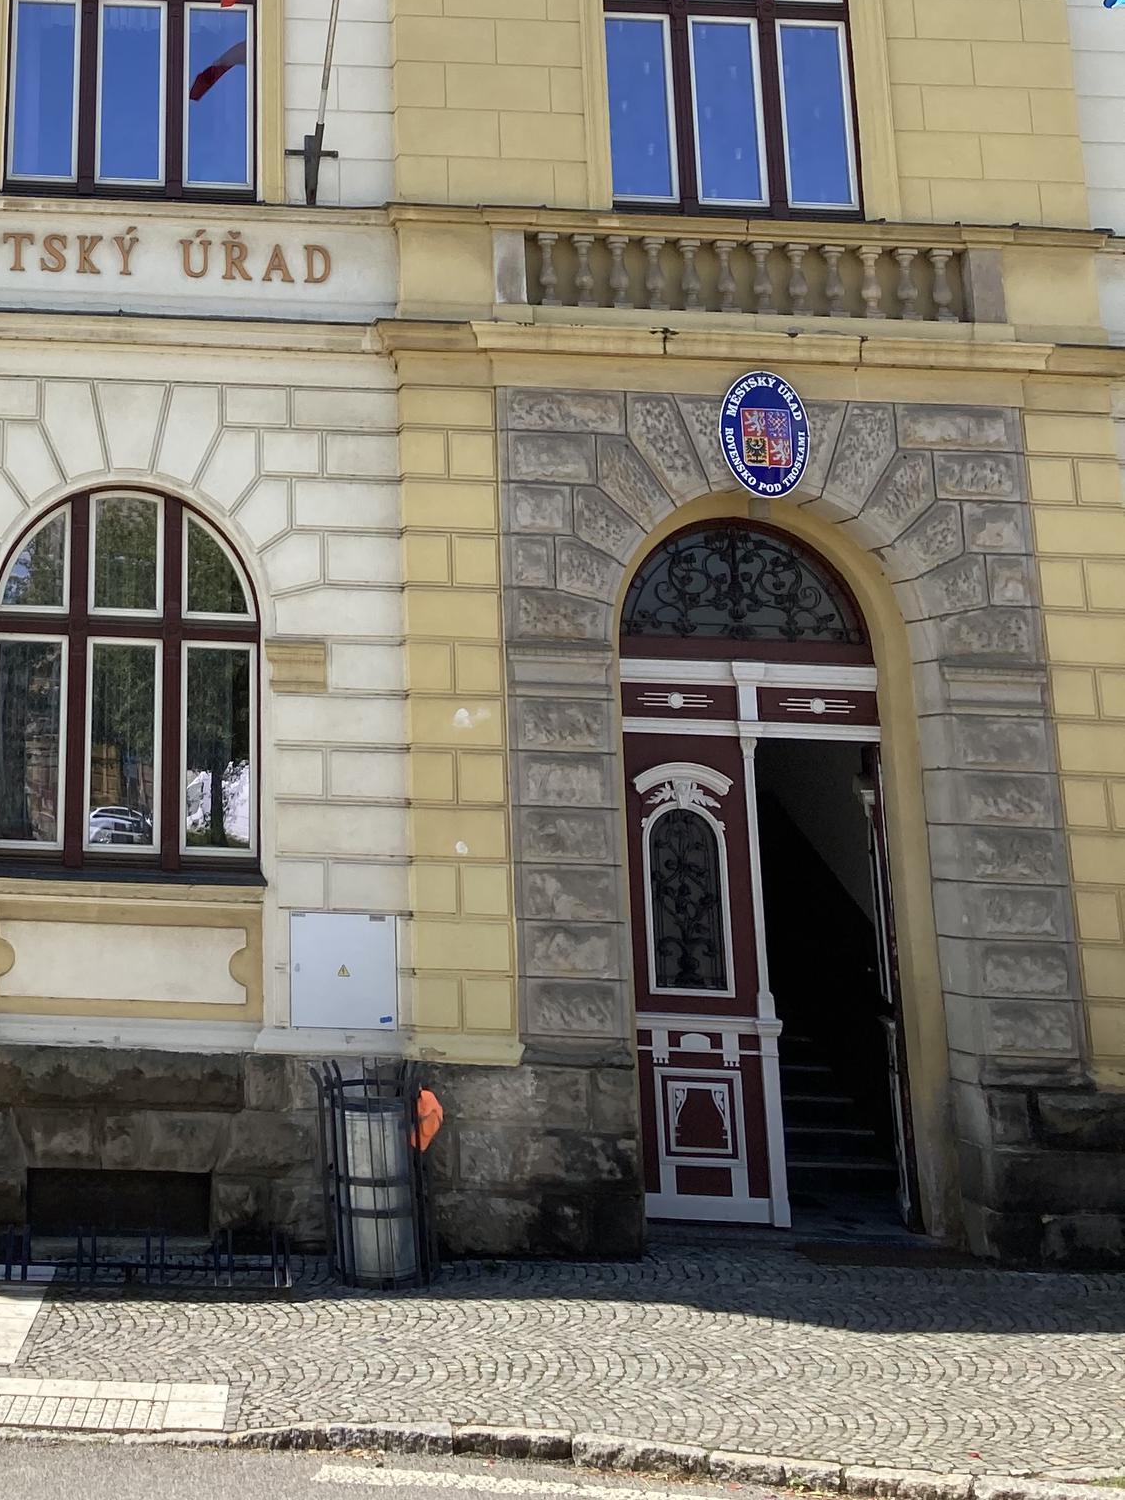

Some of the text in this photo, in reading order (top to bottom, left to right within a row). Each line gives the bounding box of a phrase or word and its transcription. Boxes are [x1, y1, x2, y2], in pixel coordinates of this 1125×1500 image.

[179, 228, 332, 285] ÚŘAD
[725, 376, 803, 421] MĚSTSKÝ ÚŘAD
[724, 427, 806, 493] ROVENSKO POD TROSKAMI
